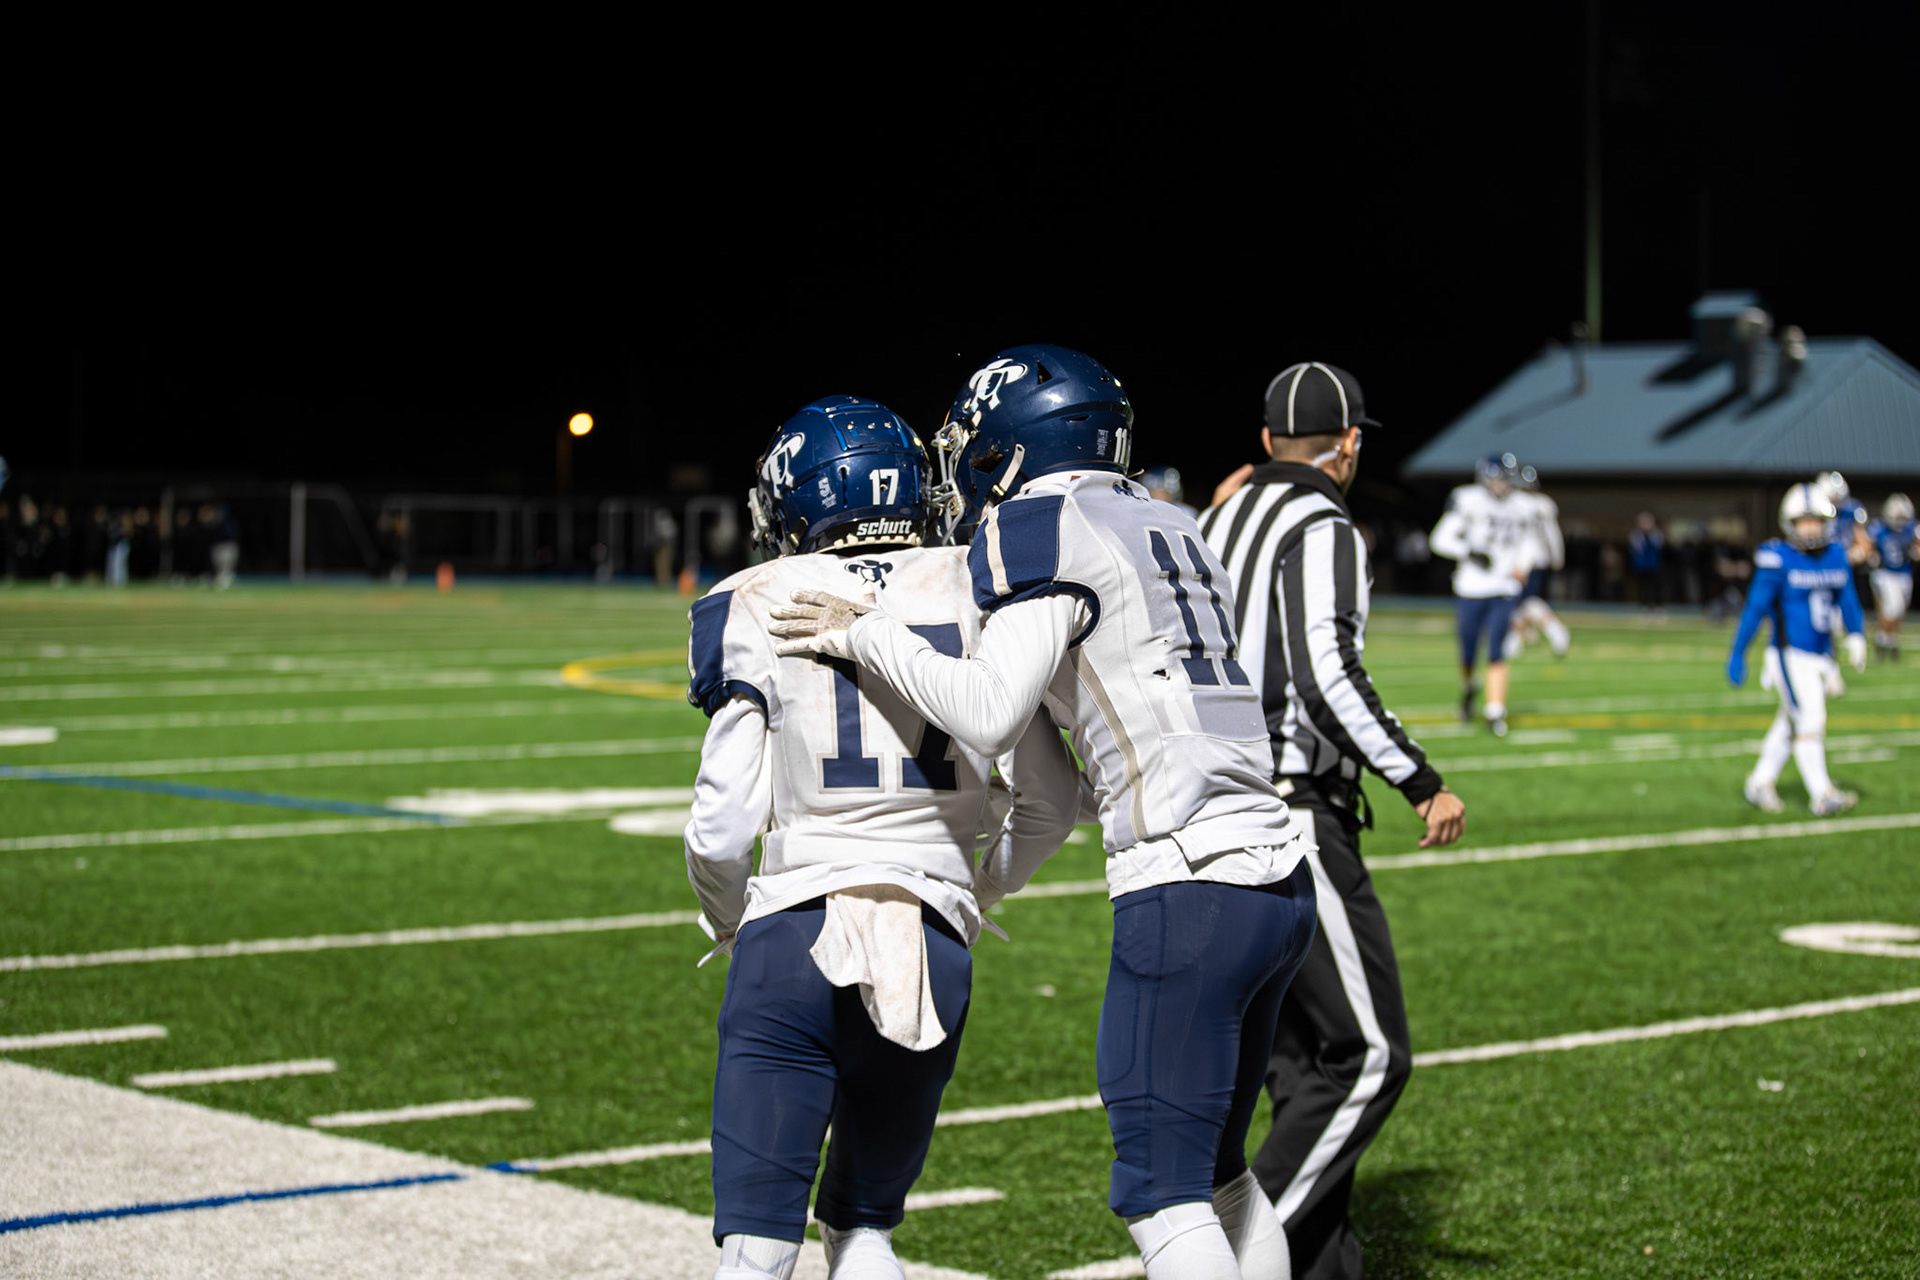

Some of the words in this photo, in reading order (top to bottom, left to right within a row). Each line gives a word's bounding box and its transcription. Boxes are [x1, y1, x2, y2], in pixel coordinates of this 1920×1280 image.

[1114, 427, 1128, 464] 11
[869, 468, 899, 506] 17
[856, 518, 912, 536] schutt
[1144, 526, 1254, 691] 11
